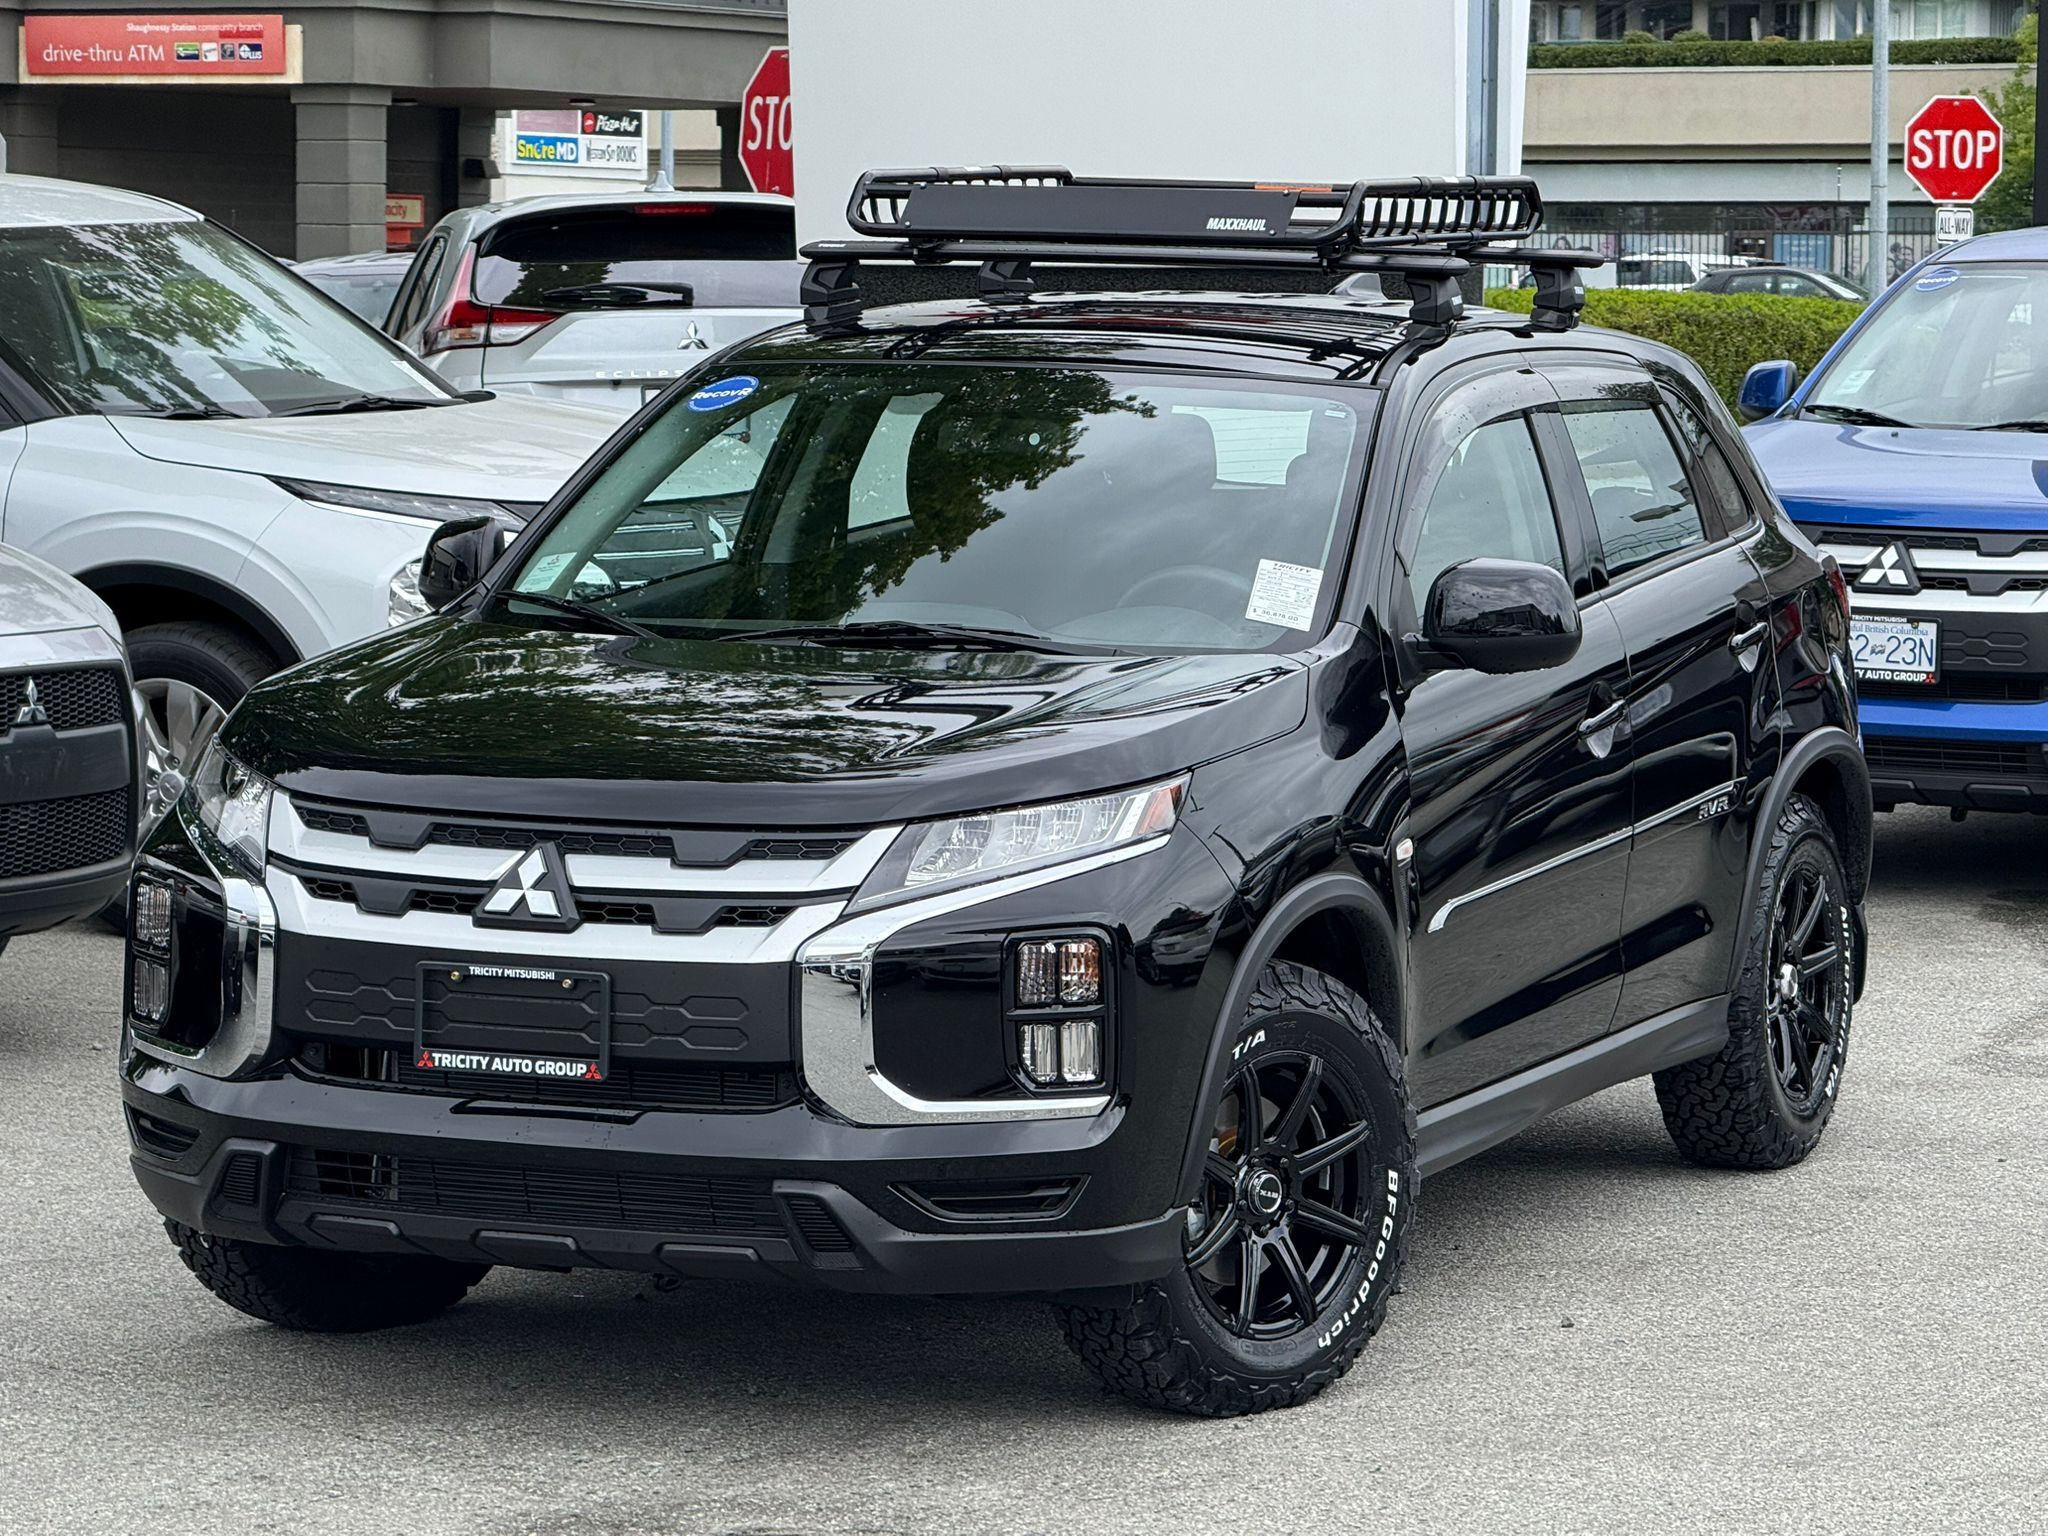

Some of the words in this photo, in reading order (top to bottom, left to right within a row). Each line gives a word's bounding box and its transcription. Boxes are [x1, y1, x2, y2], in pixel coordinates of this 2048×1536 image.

[172, 23, 197, 32] Station
[198, 24, 237, 33] community
[239, 23, 264, 31] branch
[43, 43, 123, 61] drive-thru
[128, 44, 165, 61] ATM
[595, 114, 619, 132] Pizza
[620, 116, 639, 132] Hut
[746, 95, 793, 151] STO
[1911, 129, 1996, 169] STOP
[1206, 217, 1266, 231] MAXXHAUL
[1939, 218, 1970, 235] ALL-WAY
[595, 369, 684, 379] ECLIPS
[1865, 625, 1889, 634] British
[1890, 626, 1928, 637] Columbia
[1886, 636, 1933, 667] 23N
[1865, 670, 1891, 680] AUTO
[1893, 672, 1927, 682] GROUP
[468, 966, 502, 978] TRICITY
[503, 968, 555, 980] MITSUBISHI
[1232, 1029, 1266, 1060] T/A
[432, 1053, 489, 1070] TRICITY
[491, 1060, 533, 1074] AUTO
[534, 1063, 588, 1077] GROUP
[1318, 1168, 1399, 1349] BFGoodrich
